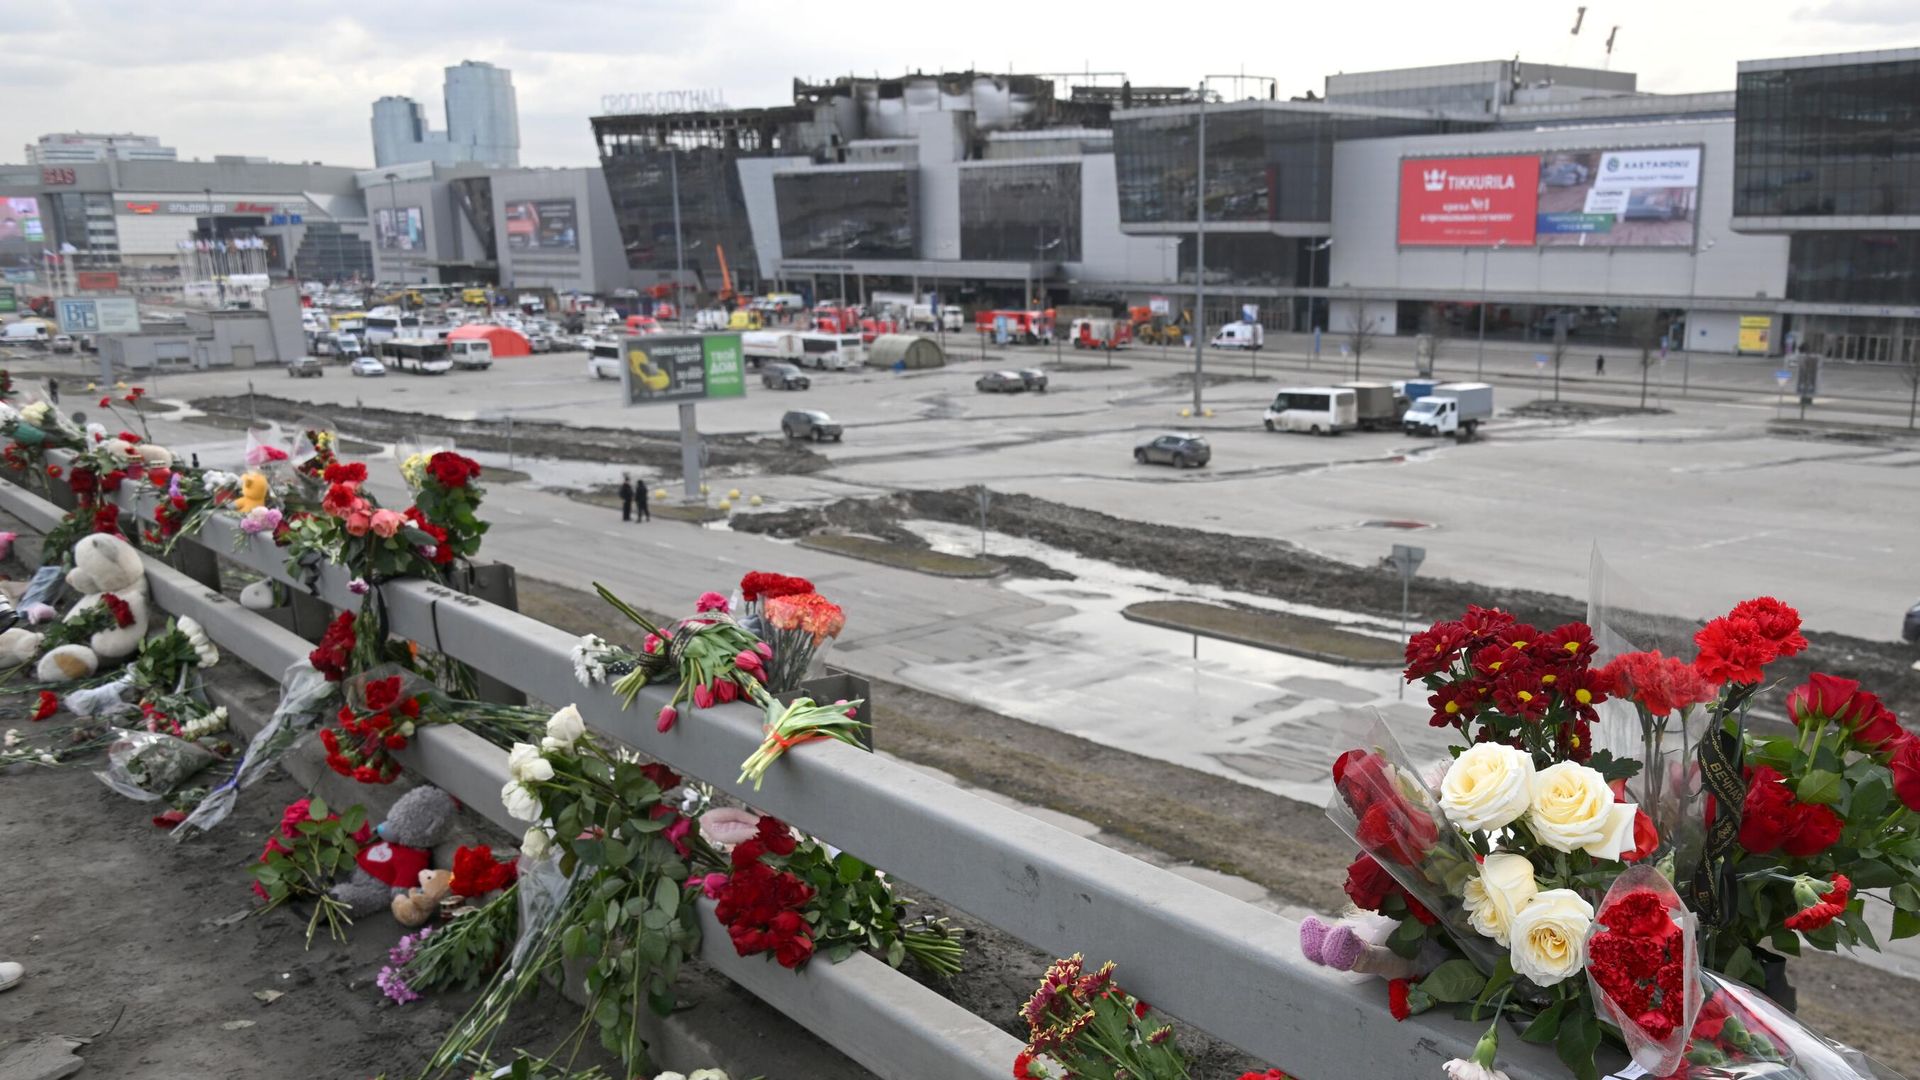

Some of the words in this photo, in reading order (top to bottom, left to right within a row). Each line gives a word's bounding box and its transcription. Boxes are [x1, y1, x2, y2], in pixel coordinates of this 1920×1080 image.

[1448, 175, 1515, 190] TIKKURILA
[711, 348, 736, 361] ТВОЙ
[711, 361, 737, 374] ДОМ
[1710, 762, 1742, 802] ВЕЧНАЯ
